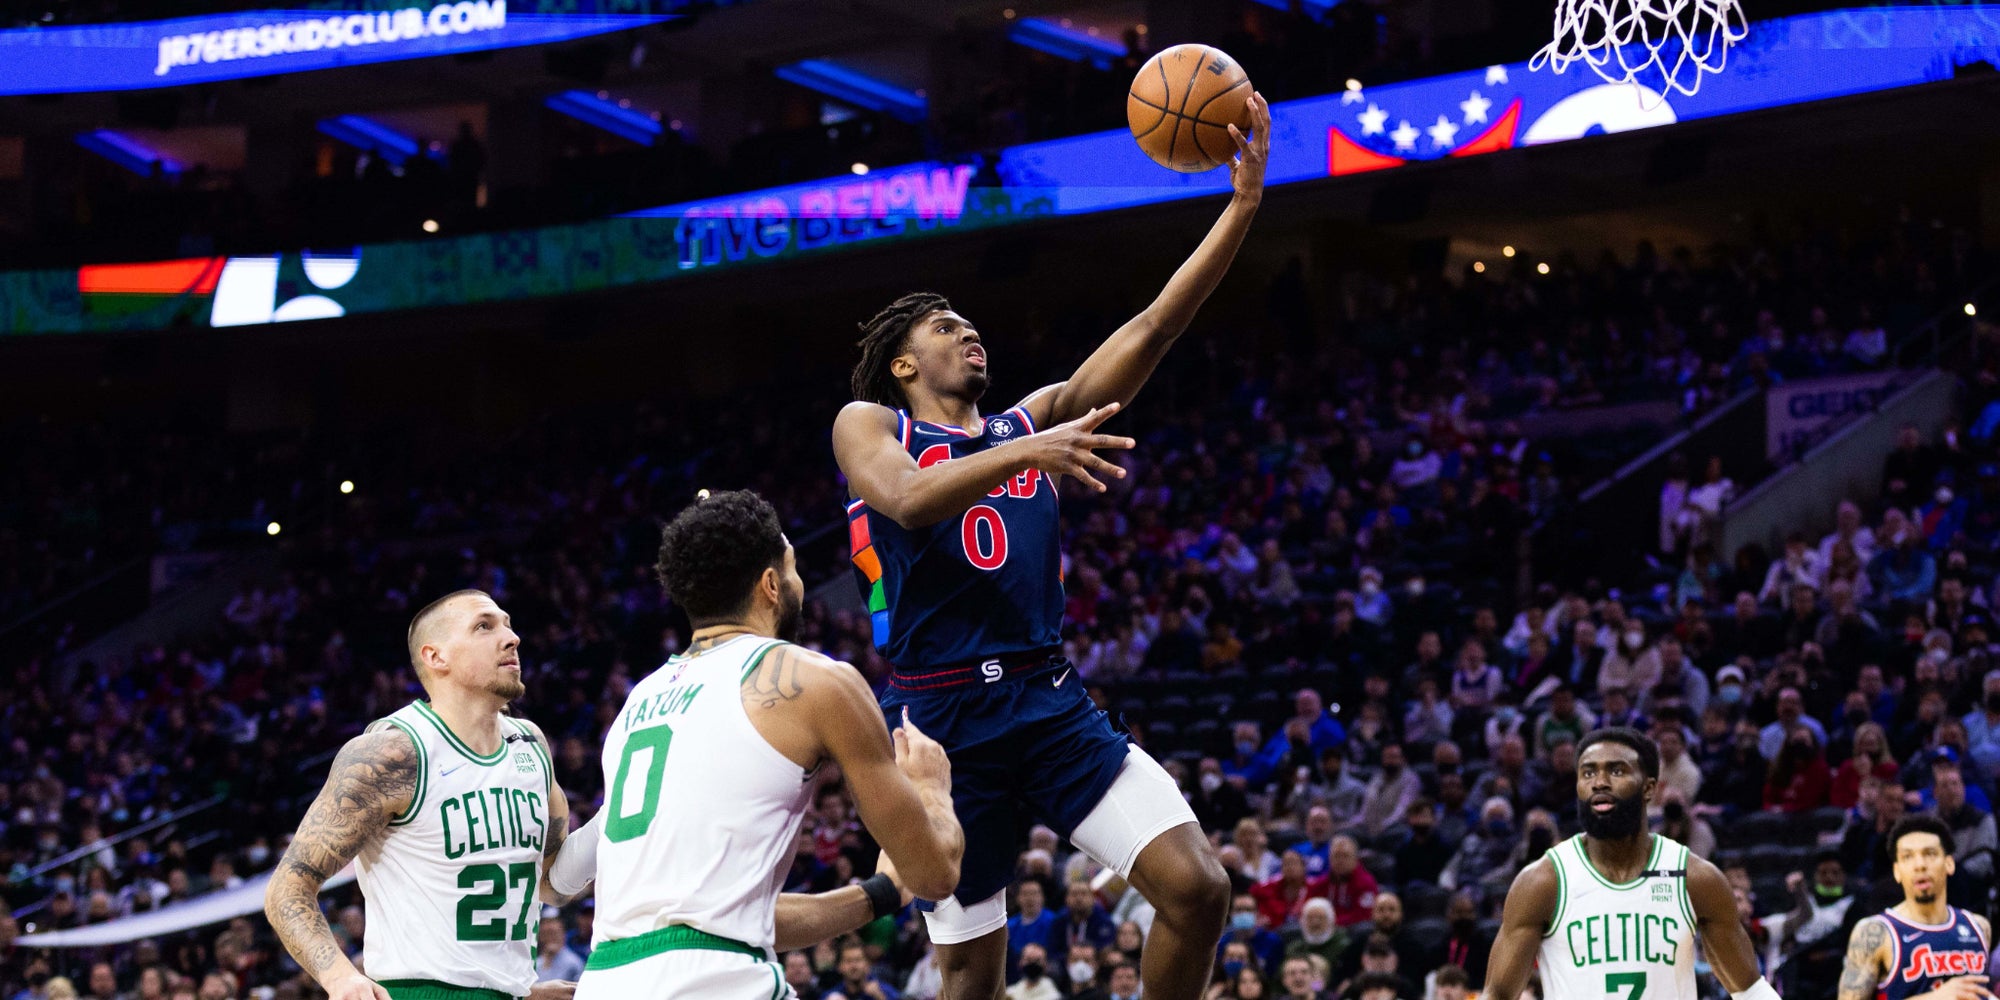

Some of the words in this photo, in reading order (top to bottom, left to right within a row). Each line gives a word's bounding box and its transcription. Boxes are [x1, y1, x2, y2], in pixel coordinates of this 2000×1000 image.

[154, 0, 505, 76] JR76ERSKIDSCLUB.COM
[961, 504, 1008, 571] 0
[625, 684, 704, 732] TATUM
[605, 723, 673, 843] 0
[440, 787, 545, 860] CELTICS
[456, 861, 537, 941] 27
[1651, 883, 1673, 893] VISTA
[1651, 895, 1673, 903] PRINT
[1567, 913, 1678, 967] CELTICS
[1902, 943, 1987, 983] Sixers
